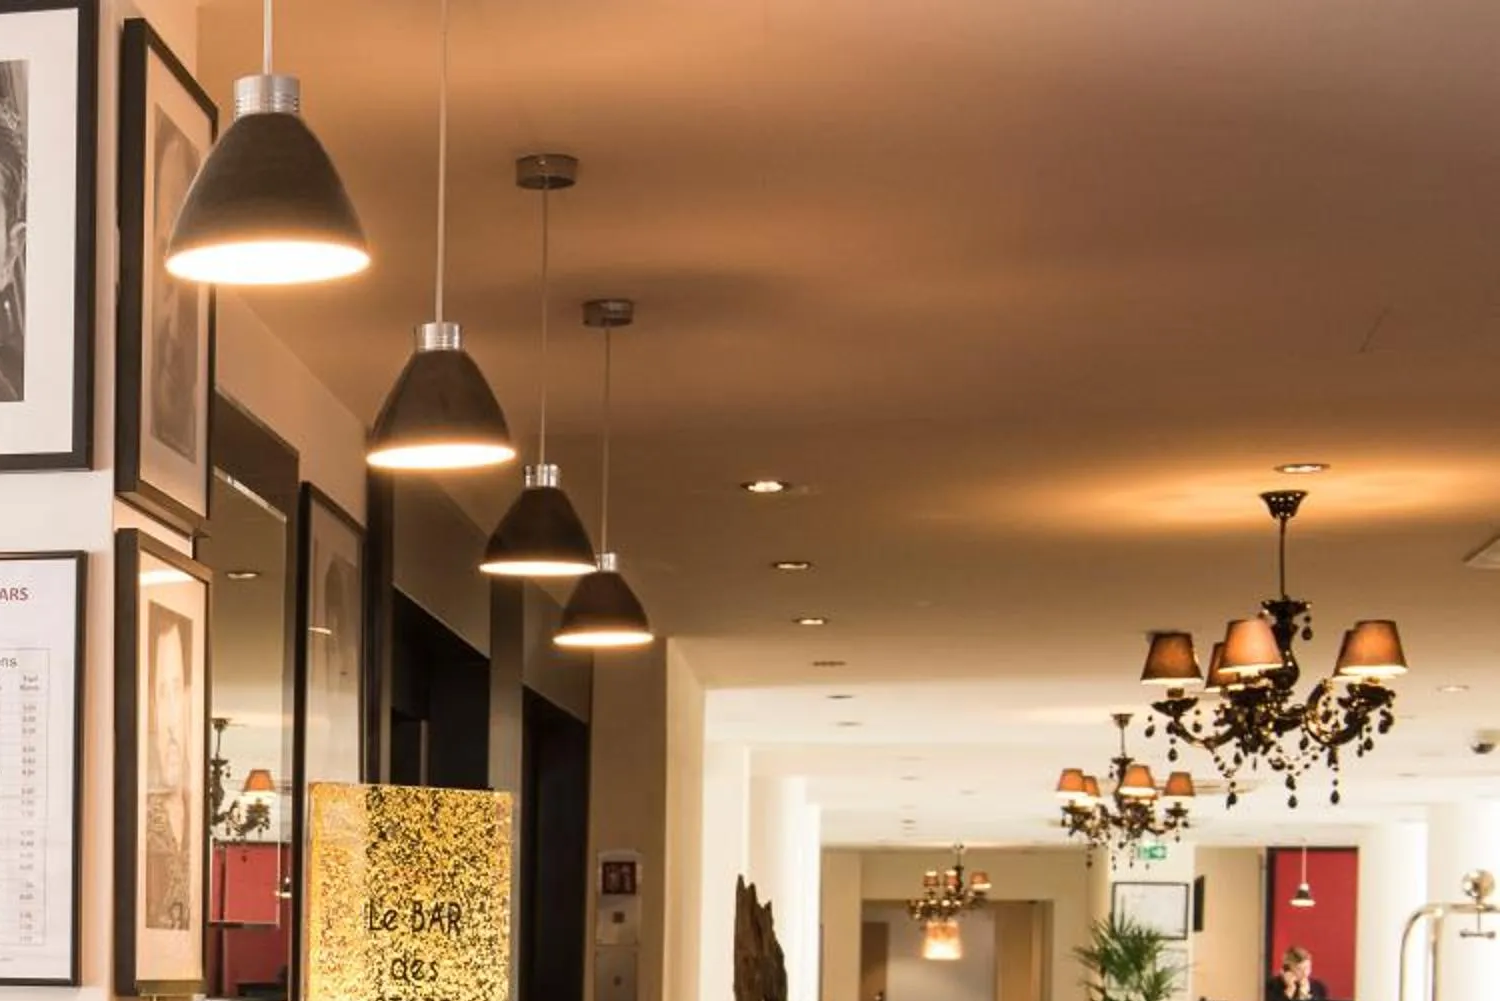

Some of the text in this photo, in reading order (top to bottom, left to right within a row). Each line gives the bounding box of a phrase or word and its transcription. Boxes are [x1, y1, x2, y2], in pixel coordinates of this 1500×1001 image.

[367, 902, 463, 936] Le BAR
[389, 950, 440, 982] des
